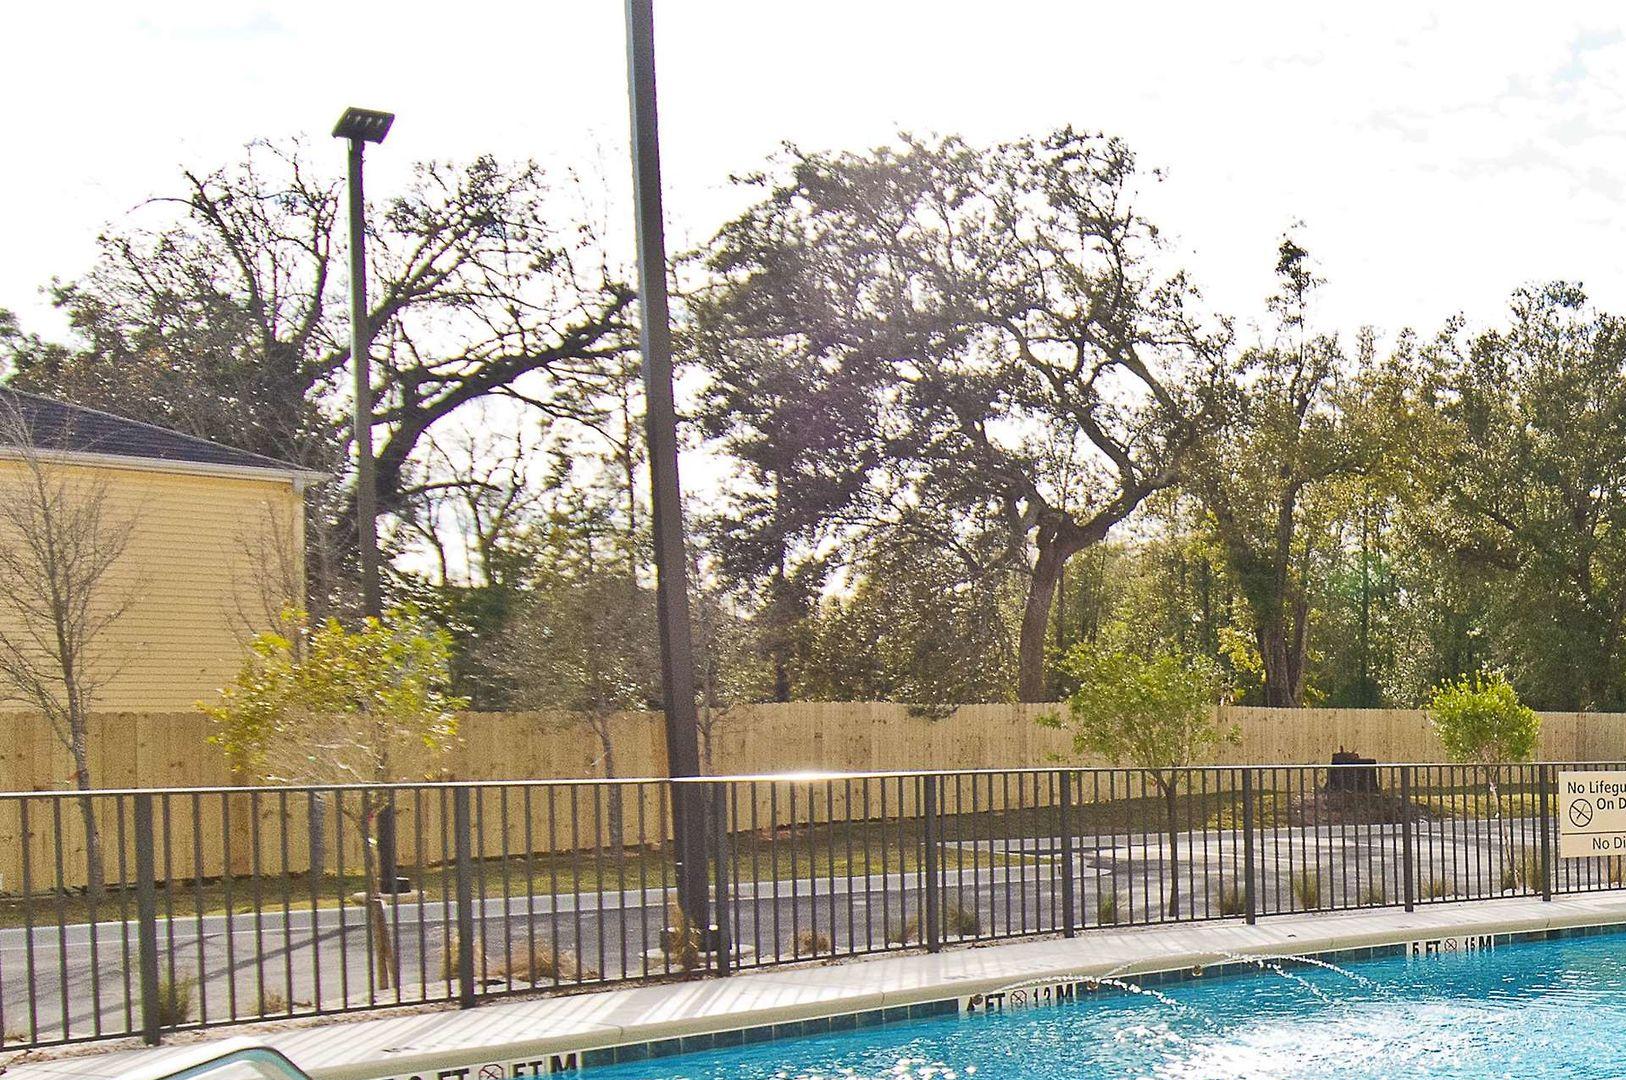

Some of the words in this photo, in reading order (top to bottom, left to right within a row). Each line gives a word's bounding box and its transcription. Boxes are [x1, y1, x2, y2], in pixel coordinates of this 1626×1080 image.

[1567, 781, 1585, 794] No
[1596, 797, 1615, 810] On
[1592, 837, 1610, 850] No
[1412, 942, 1420, 955] 5
[1426, 940, 1441, 953] FT
[1478, 935, 1492, 950] M
[985, 992, 1006, 1010] FT
[1056, 983, 1074, 1001] M
[550, 1053, 577, 1073] M
